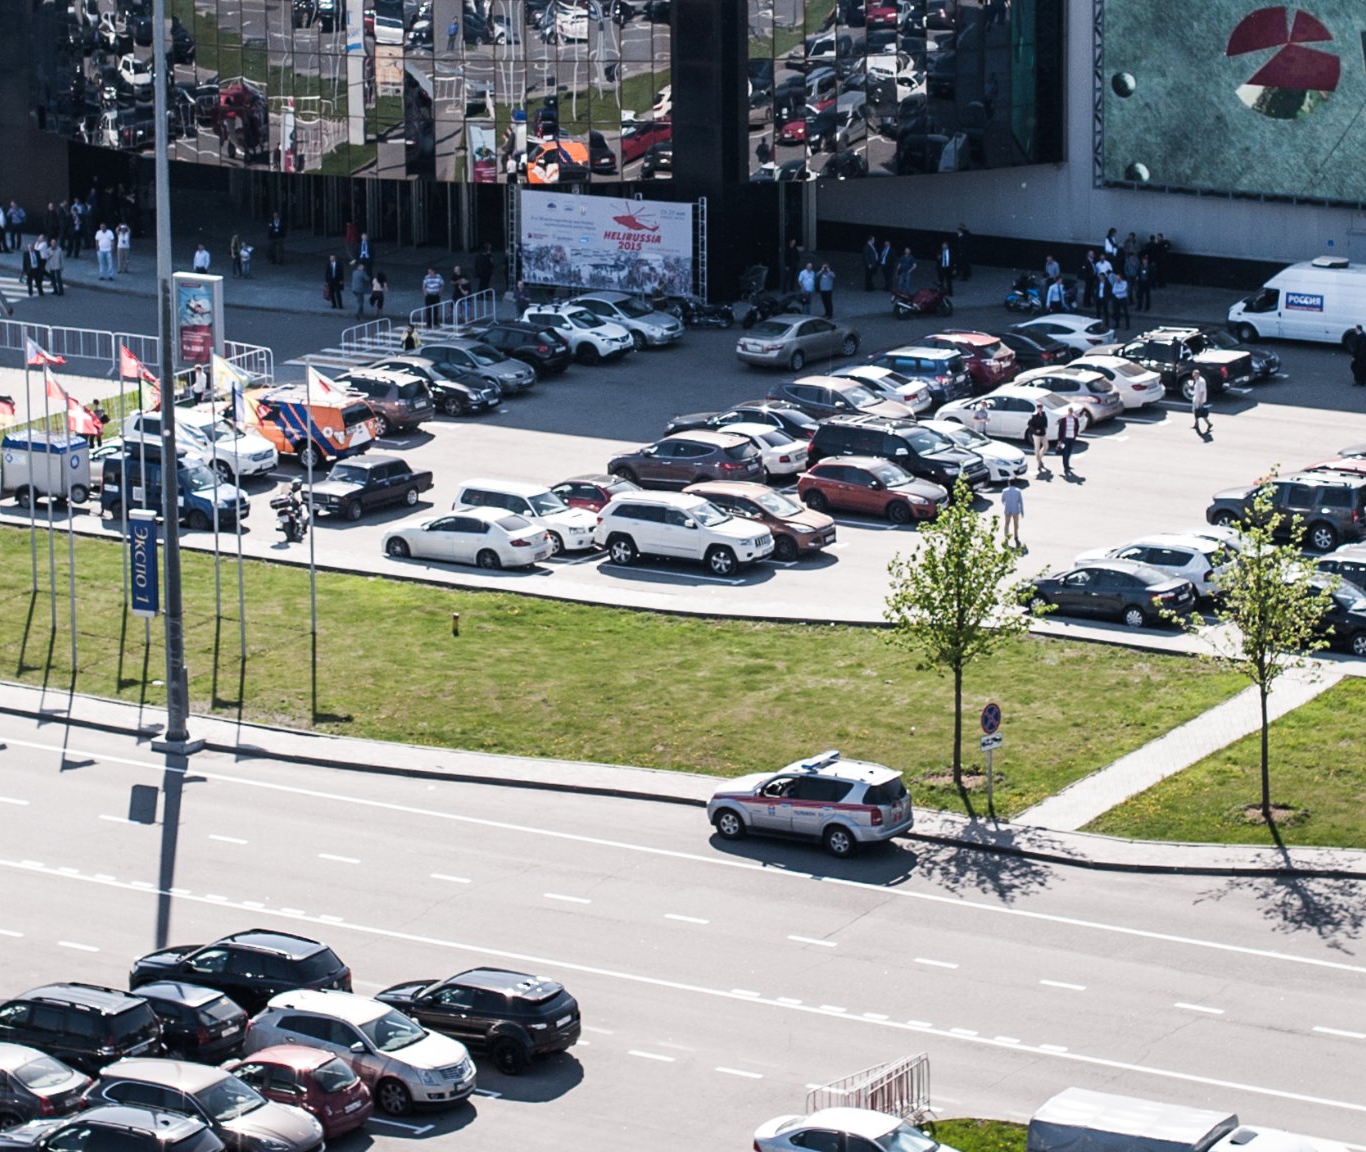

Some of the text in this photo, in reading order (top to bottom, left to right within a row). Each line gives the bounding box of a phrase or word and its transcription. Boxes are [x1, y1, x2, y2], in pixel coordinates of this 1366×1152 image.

[618, 241, 642, 251] 2015
[1288, 294, 1321, 306] РОССИЯ
[134, 525, 149, 603] ЭКСПО 1
